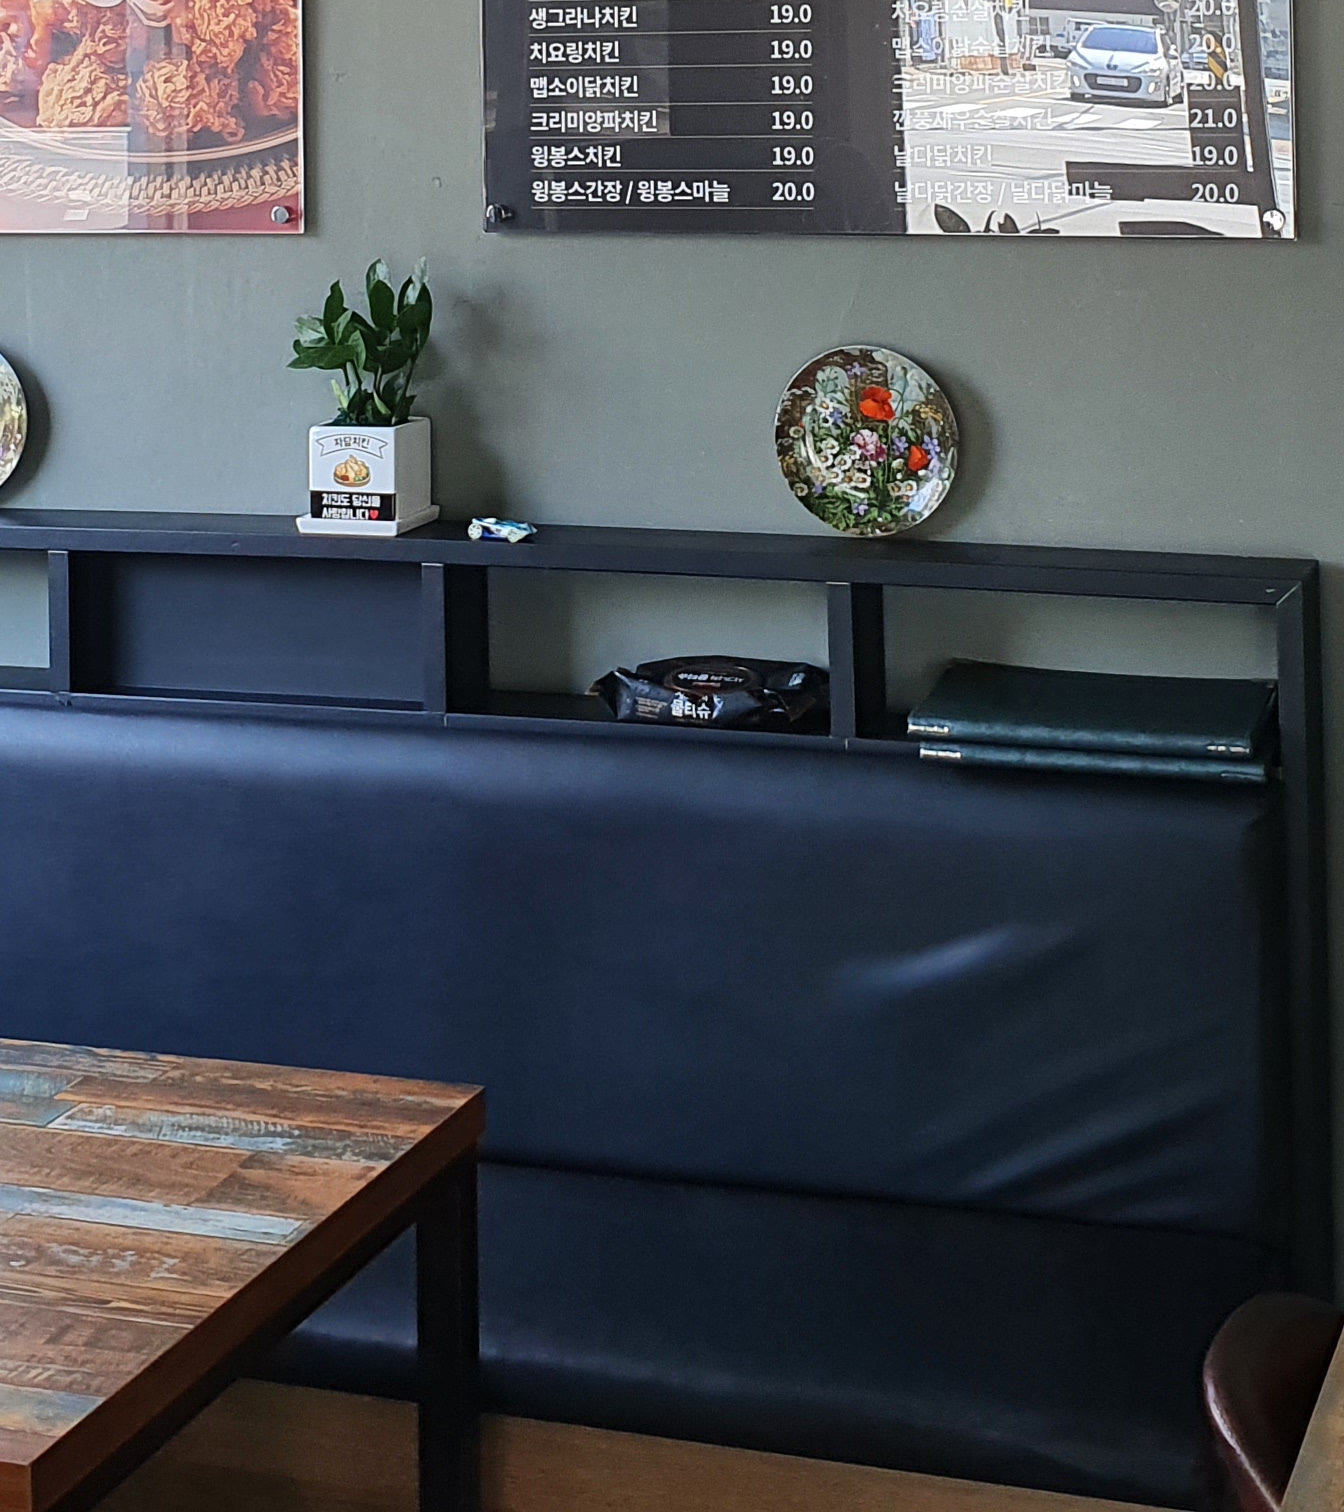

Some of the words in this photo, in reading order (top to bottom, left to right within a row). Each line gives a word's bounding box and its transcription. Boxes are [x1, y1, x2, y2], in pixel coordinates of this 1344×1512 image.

[529, 7, 638, 29] 생그라나치킨
[770, 5, 812, 23] 19.0
[530, 42, 620, 64] 치요링치킨
[770, 40, 812, 58] 19.0
[1188, 34, 1236, 54] 20.0
[530, 76, 638, 98] 맵소이닭치킨
[771, 76, 813, 94] 19.0
[530, 111, 657, 133] 크리미양파치킨
[772, 112, 814, 130] 19.0
[1190, 108, 1237, 129] 21.0
[531, 146, 621, 167] 윙봉스치킨
[772, 147, 814, 165] 19.0
[1192, 146, 1238, 166] 19.0
[532, 180, 622, 202] 윙봉스간장
[637, 180, 730, 202] 윙봉스마늘
[772, 182, 814, 200] 20.0
[1191, 183, 1239, 204] 20.0
[334, 435, 371, 449] 자담치킨
[671, 699, 712, 719] 물티슈
